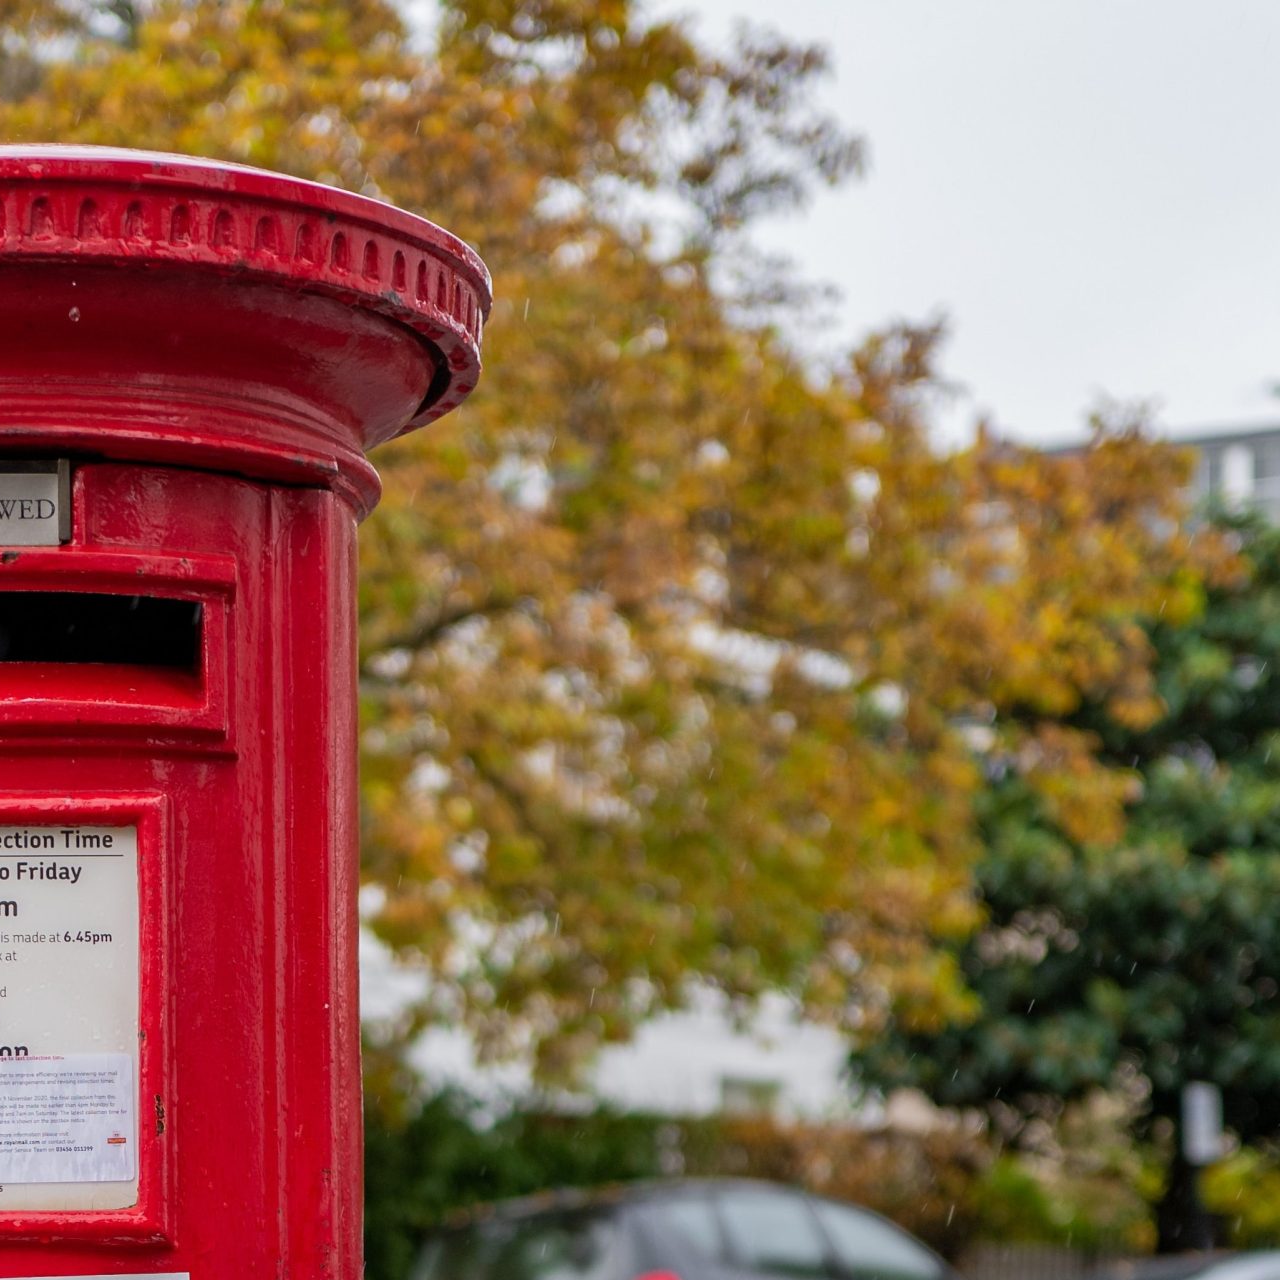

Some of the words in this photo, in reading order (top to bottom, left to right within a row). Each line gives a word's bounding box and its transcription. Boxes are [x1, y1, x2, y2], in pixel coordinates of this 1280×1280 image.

[60, 830, 114, 848] Time
[16, 861, 82, 884] Friday
[0, 932, 10, 943] is
[12, 932, 48, 943] made
[50, 932, 61, 943] at
[63, 931, 113, 946] 6.45pm
[5, 951, 17, 961] at
